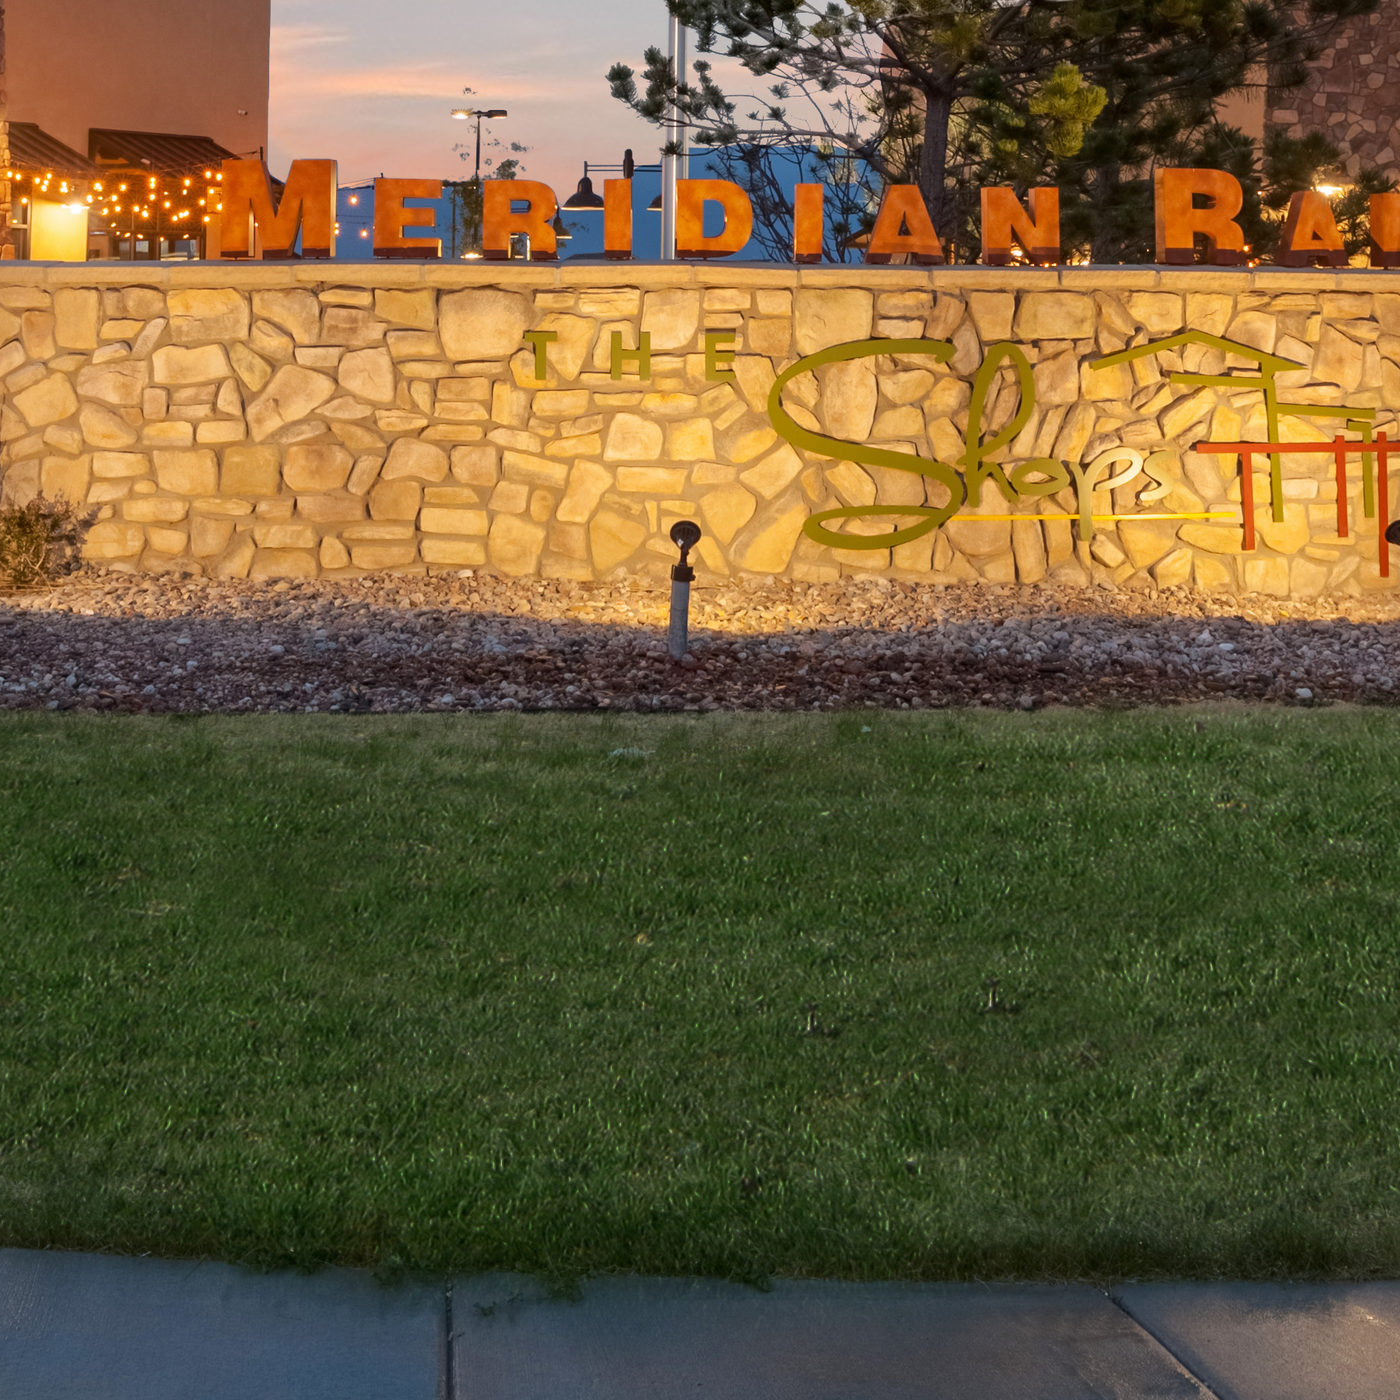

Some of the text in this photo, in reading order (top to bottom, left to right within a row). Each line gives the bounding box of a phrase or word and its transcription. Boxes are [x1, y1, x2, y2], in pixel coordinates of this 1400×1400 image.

[220, 157, 1061, 265] MERIDIAN
[524, 330, 1175, 551] THE Shops
